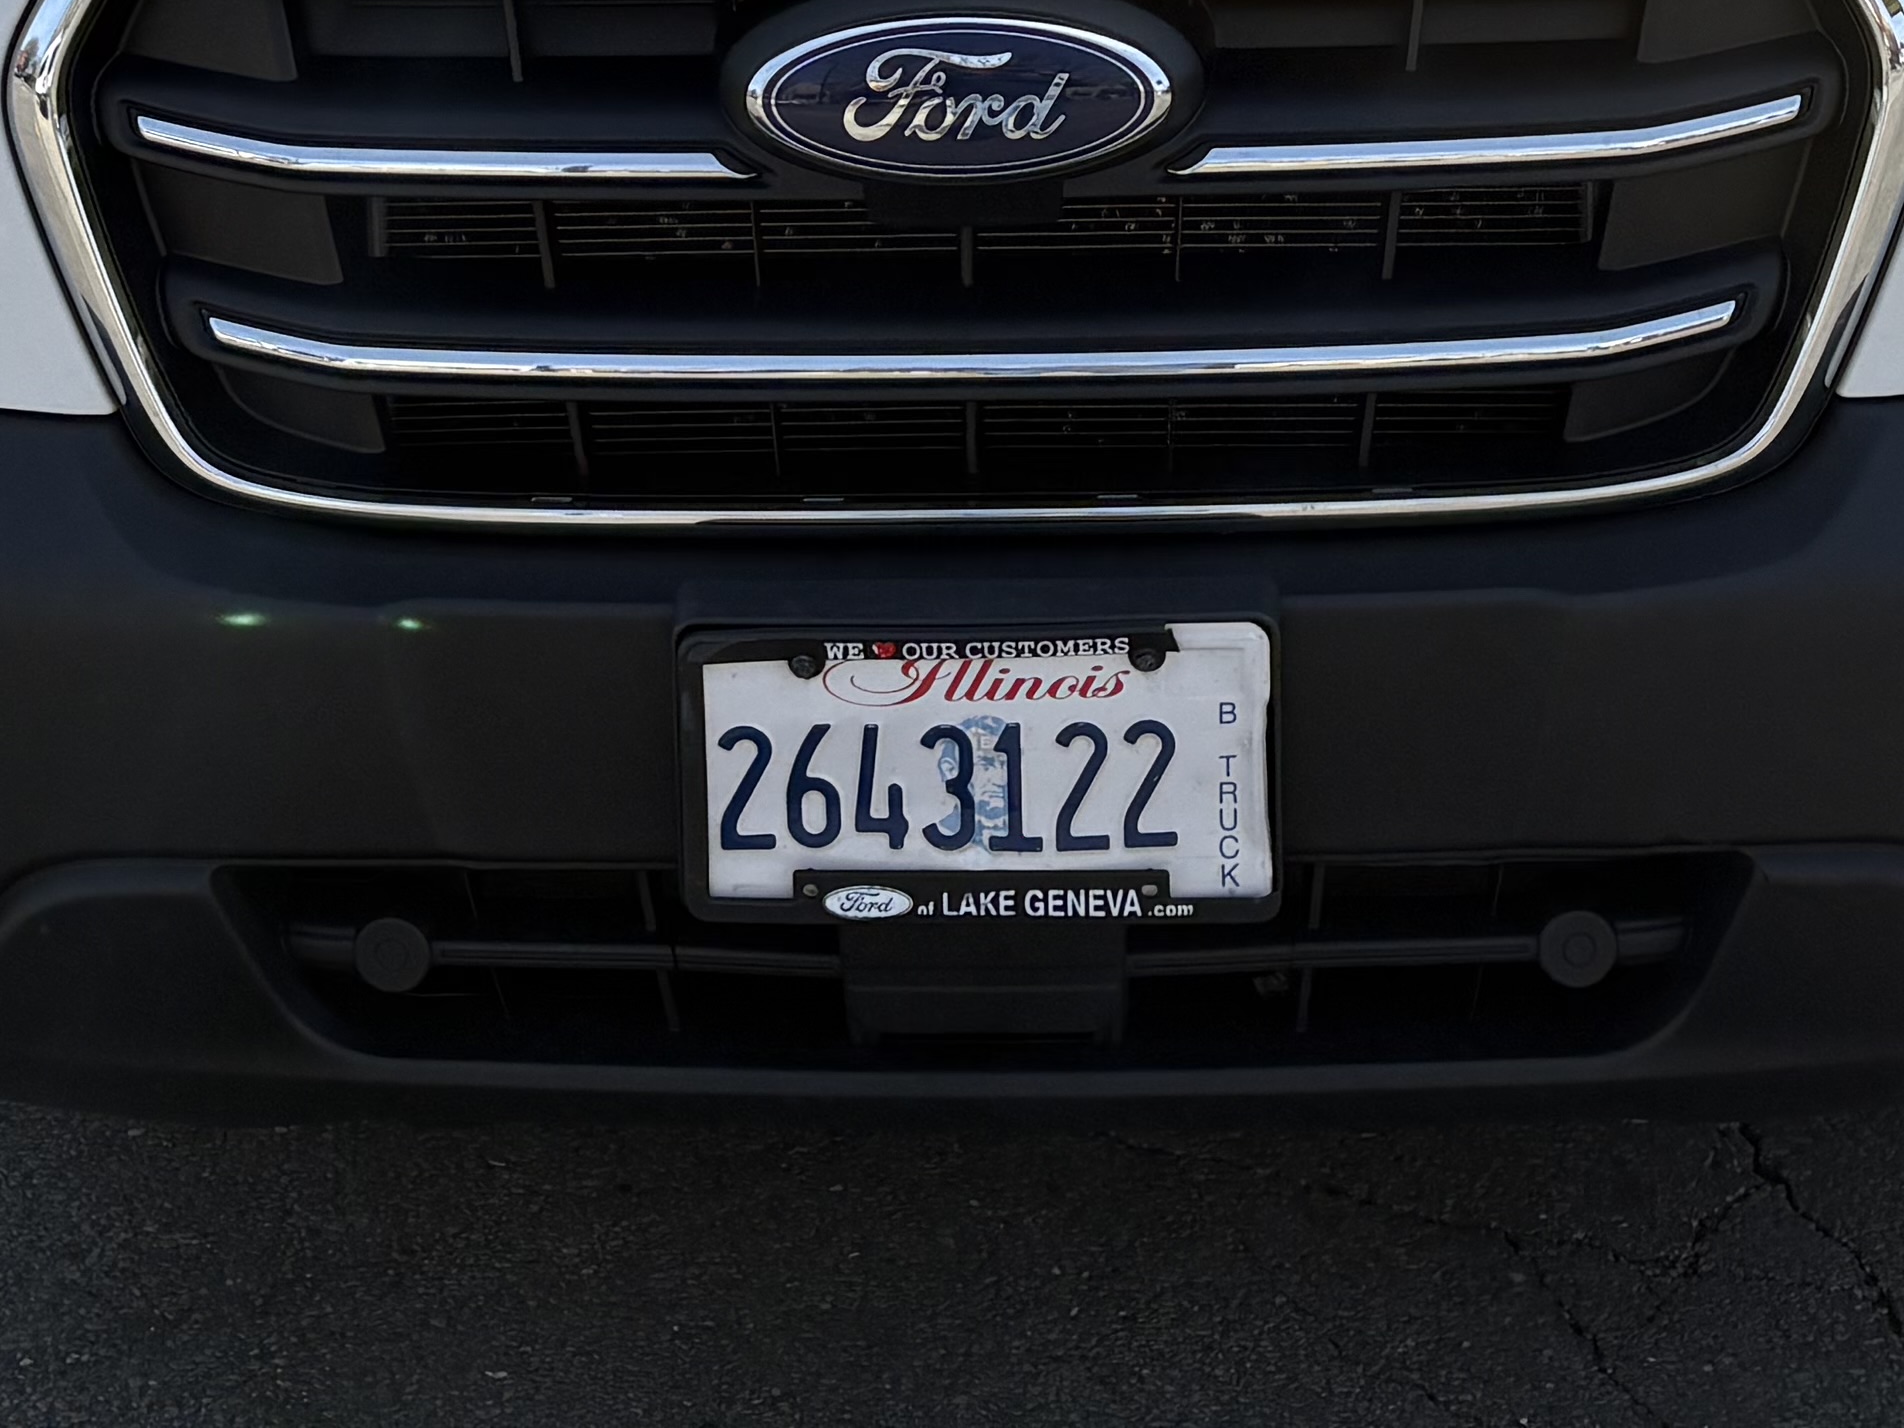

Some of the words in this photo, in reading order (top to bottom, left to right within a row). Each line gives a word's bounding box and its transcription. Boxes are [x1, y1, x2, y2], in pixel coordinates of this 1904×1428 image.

[843, 48, 1071, 142] Ford
[824, 642, 864, 660] WE
[902, 642, 960, 660] OUR
[964, 637, 1130, 660] CUSTOMERS
[822, 658, 1130, 707] Illinois
[1219, 701, 1237, 724] B
[717, 720, 1179, 854] 2643122
[1218, 754, 1240, 888] TRUCK
[942, 890, 1016, 916] LAKE
[1024, 888, 1143, 917] GENEVA
[1147, 902, 1194, 917] .com
